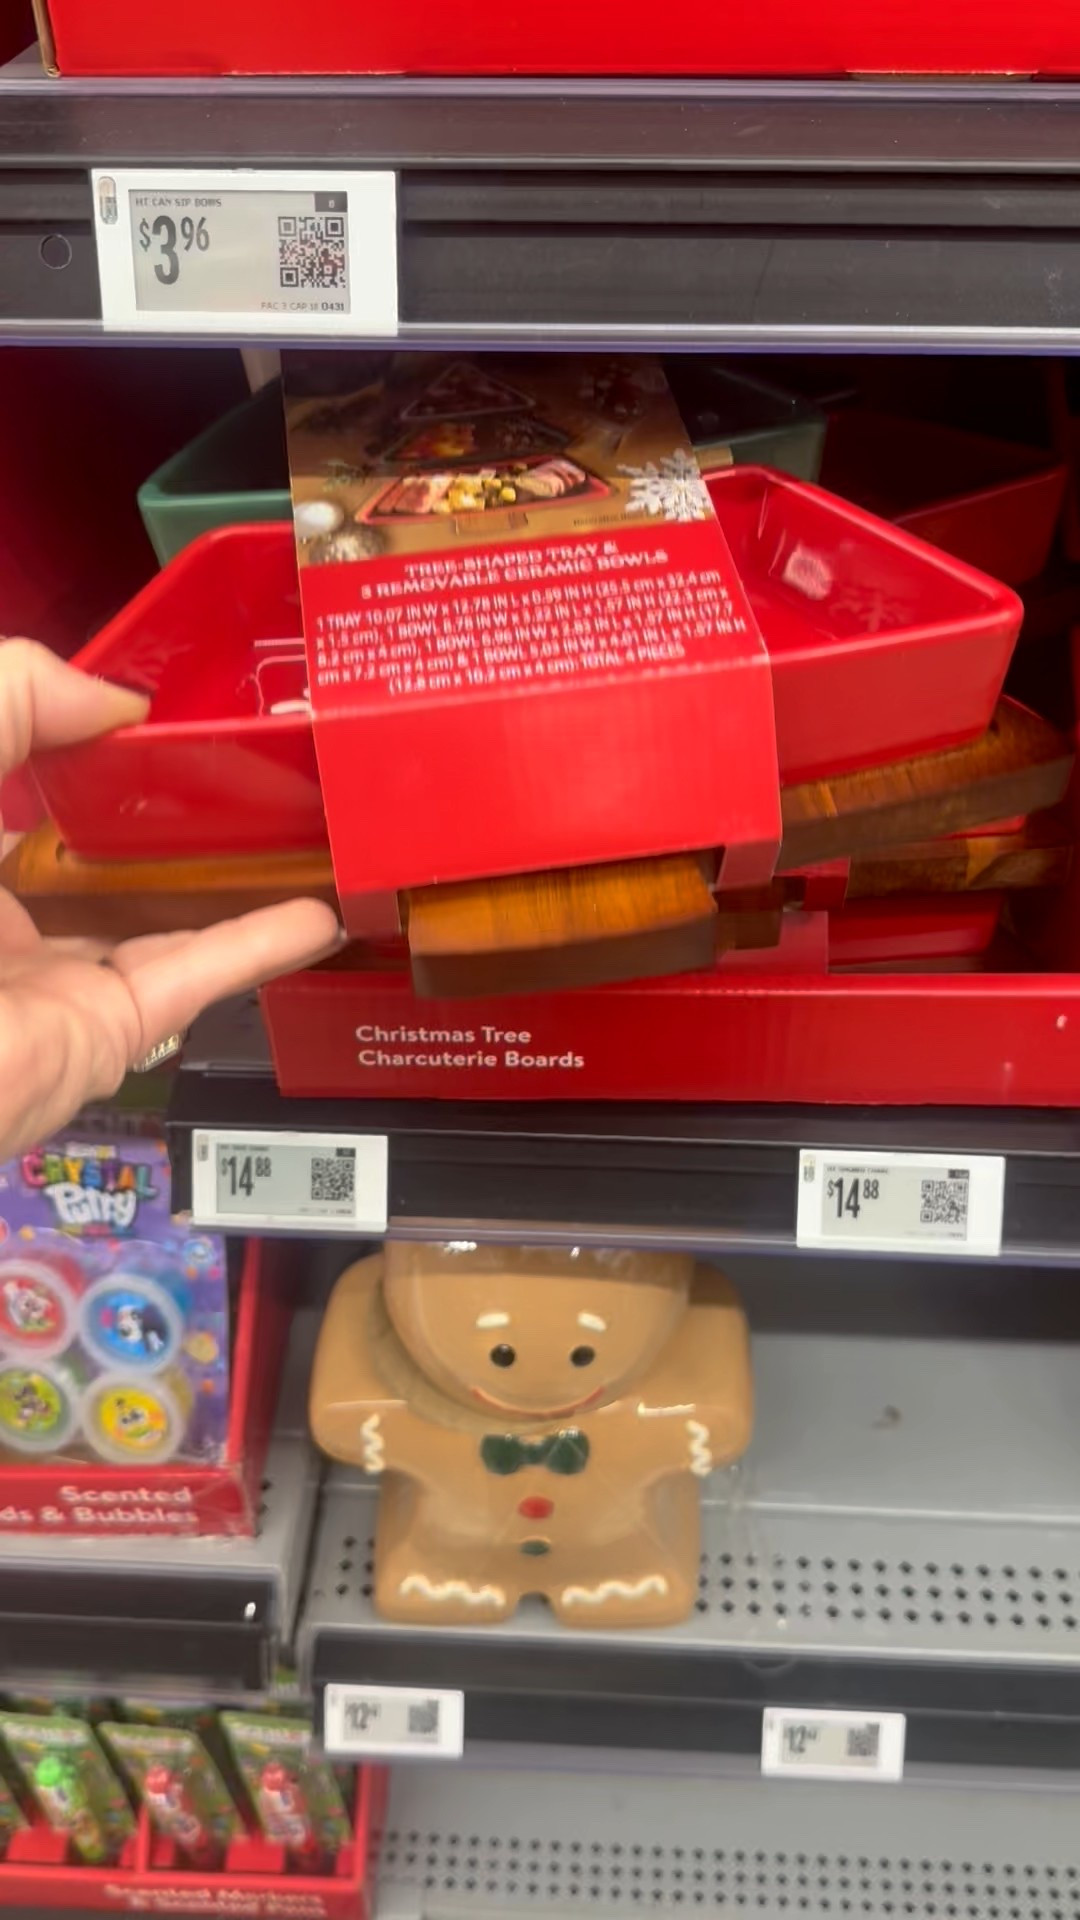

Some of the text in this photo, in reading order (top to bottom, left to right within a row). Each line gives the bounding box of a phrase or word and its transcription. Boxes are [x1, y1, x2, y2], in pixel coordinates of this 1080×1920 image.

[321, 302, 345, 311] 0431
[376, 569, 499, 597] REMOVABLE
[504, 558, 592, 582] CERAMIC
[597, 549, 668, 571] BOWLS
[404, 540, 618, 578] TREE-SHAPED TRAY &
[326, 610, 360, 629] TRAY
[365, 605, 402, 624] 10.07
[406, 603, 420, 619] IN
[423, 601, 437, 617] W
[492, 593, 507, 609] IN
[564, 584, 579, 600] IN
[581, 582, 593, 598] H
[633, 578, 654, 592] cm
[699, 570, 720, 584] cm
[397, 618, 439, 638] BOWL
[475, 612, 490, 629] IN
[492, 610, 507, 627] W
[554, 602, 569, 619] IN
[625, 593, 641, 611] IN
[643, 592, 655, 609] H
[695, 587, 717, 602] cm
[317, 670, 339, 685] cm
[378, 662, 400, 677] cm
[426, 653, 453, 672] cm)
[483, 644, 527, 664] BOWL
[562, 637, 578, 655] IN
[579, 635, 595, 653] W
[642, 627, 659, 645] IN
[715, 619, 732, 636] IN
[733, 617, 746, 634] H
[343, 648, 364, 663] cm
[436, 631, 479, 652] BOWL
[514, 625, 529, 642] IN
[531, 623, 546, 640] W
[593, 615, 609, 633] IN
[665, 607, 682, 624] IN
[428, 673, 450, 688] cm
[498, 665, 520, 680] cm
[581, 649, 623, 669] TOTAL
[637, 641, 685, 663] PIECES
[355, 1025, 532, 1043] Christmas Tree
[358, 1050, 585, 1068] Charcuterie Boards
[22, 1145, 158, 1198] CRYSTAL
[40, 1506, 64, 1522] &
[73, 1506, 198, 1522] Bubbles
[60, 1486, 192, 1502] Scented
